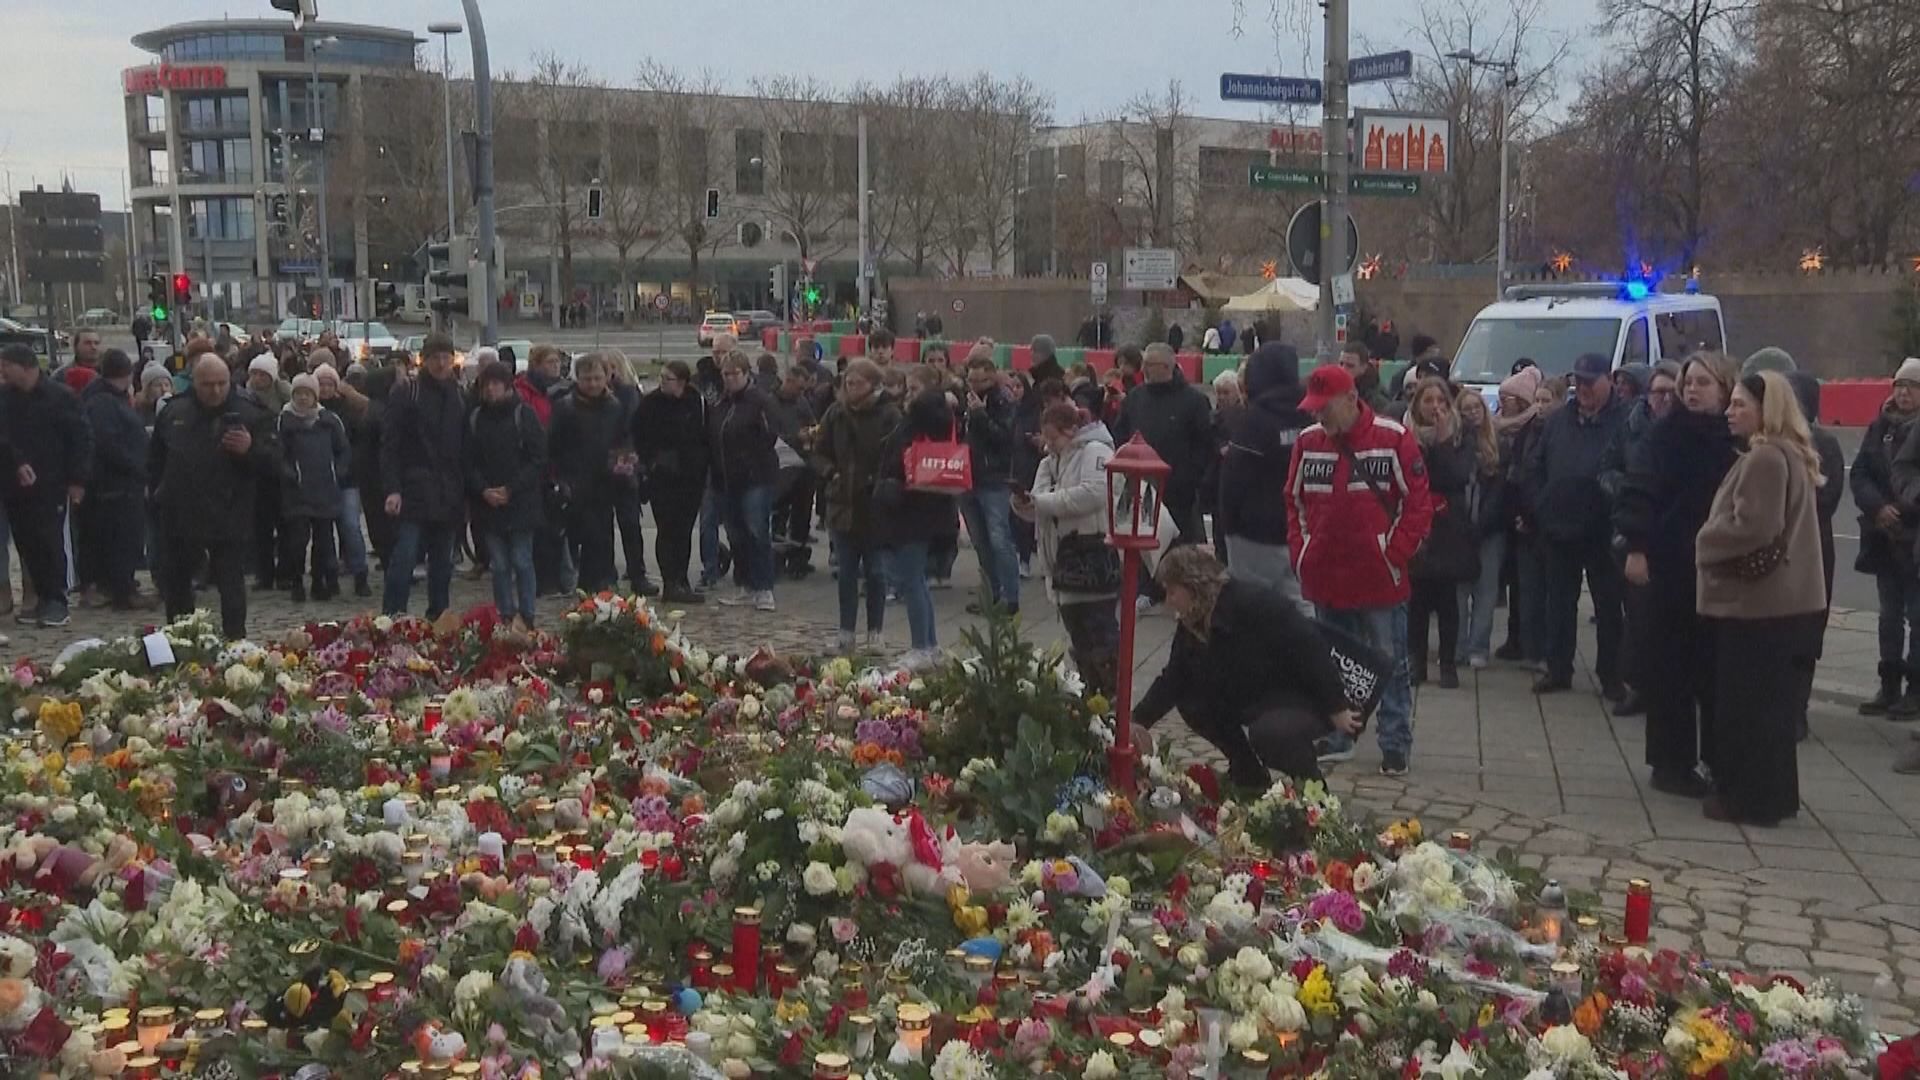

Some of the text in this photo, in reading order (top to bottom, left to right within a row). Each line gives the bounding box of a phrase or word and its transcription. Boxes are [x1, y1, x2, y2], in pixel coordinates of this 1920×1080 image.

[1354, 57, 1405, 78] Jakobstraße
[1226, 79, 1317, 99] Johannisbergstraße
[1304, 463, 1334, 478] CAMP
